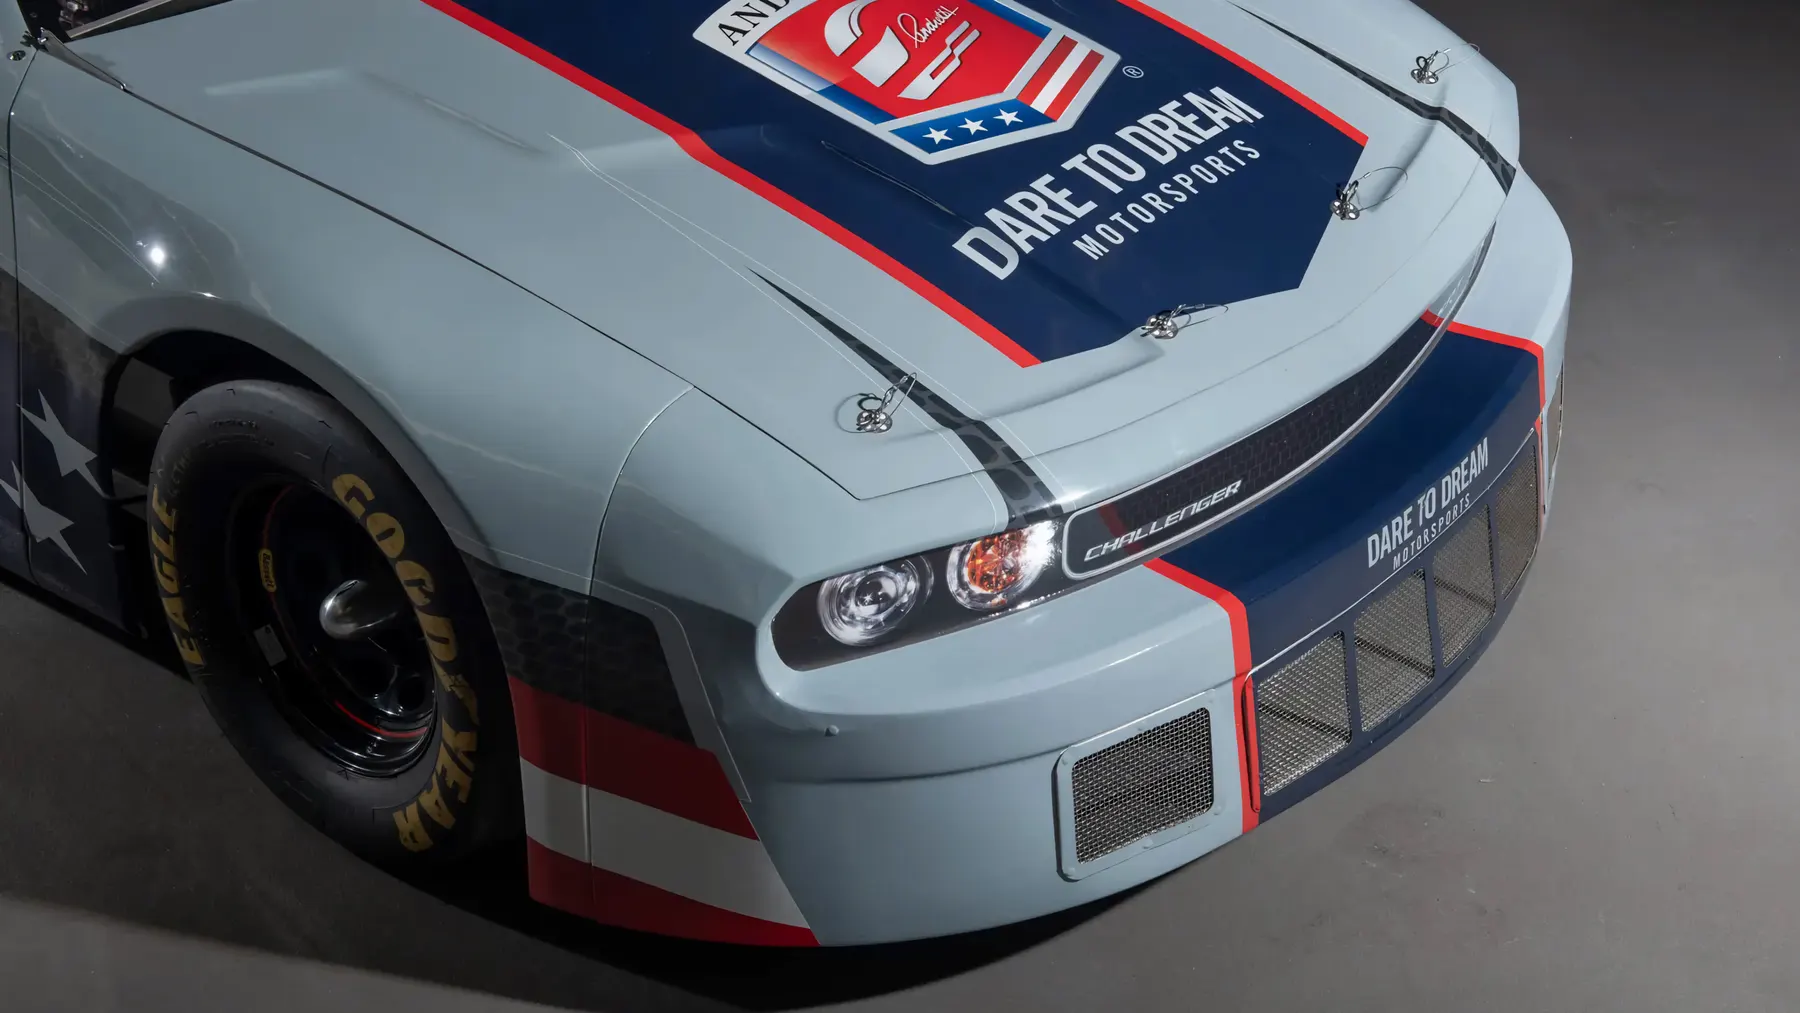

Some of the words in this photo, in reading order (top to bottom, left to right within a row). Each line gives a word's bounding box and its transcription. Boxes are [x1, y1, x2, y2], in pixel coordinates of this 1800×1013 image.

[952, 173, 1098, 280] DARE
[1061, 143, 1146, 194] TO
[1115, 86, 1264, 165] DREAM
[1072, 139, 1260, 260] MOTORSPORTS
[1084, 479, 1242, 562] CHALLENGER
[1367, 506, 1413, 568] DARE
[1418, 487, 1436, 527] TO
[1442, 437, 1488, 509] DREAM
[1393, 493, 1470, 570] MOTORSPORTS
[151, 484, 206, 665] EAGLE
